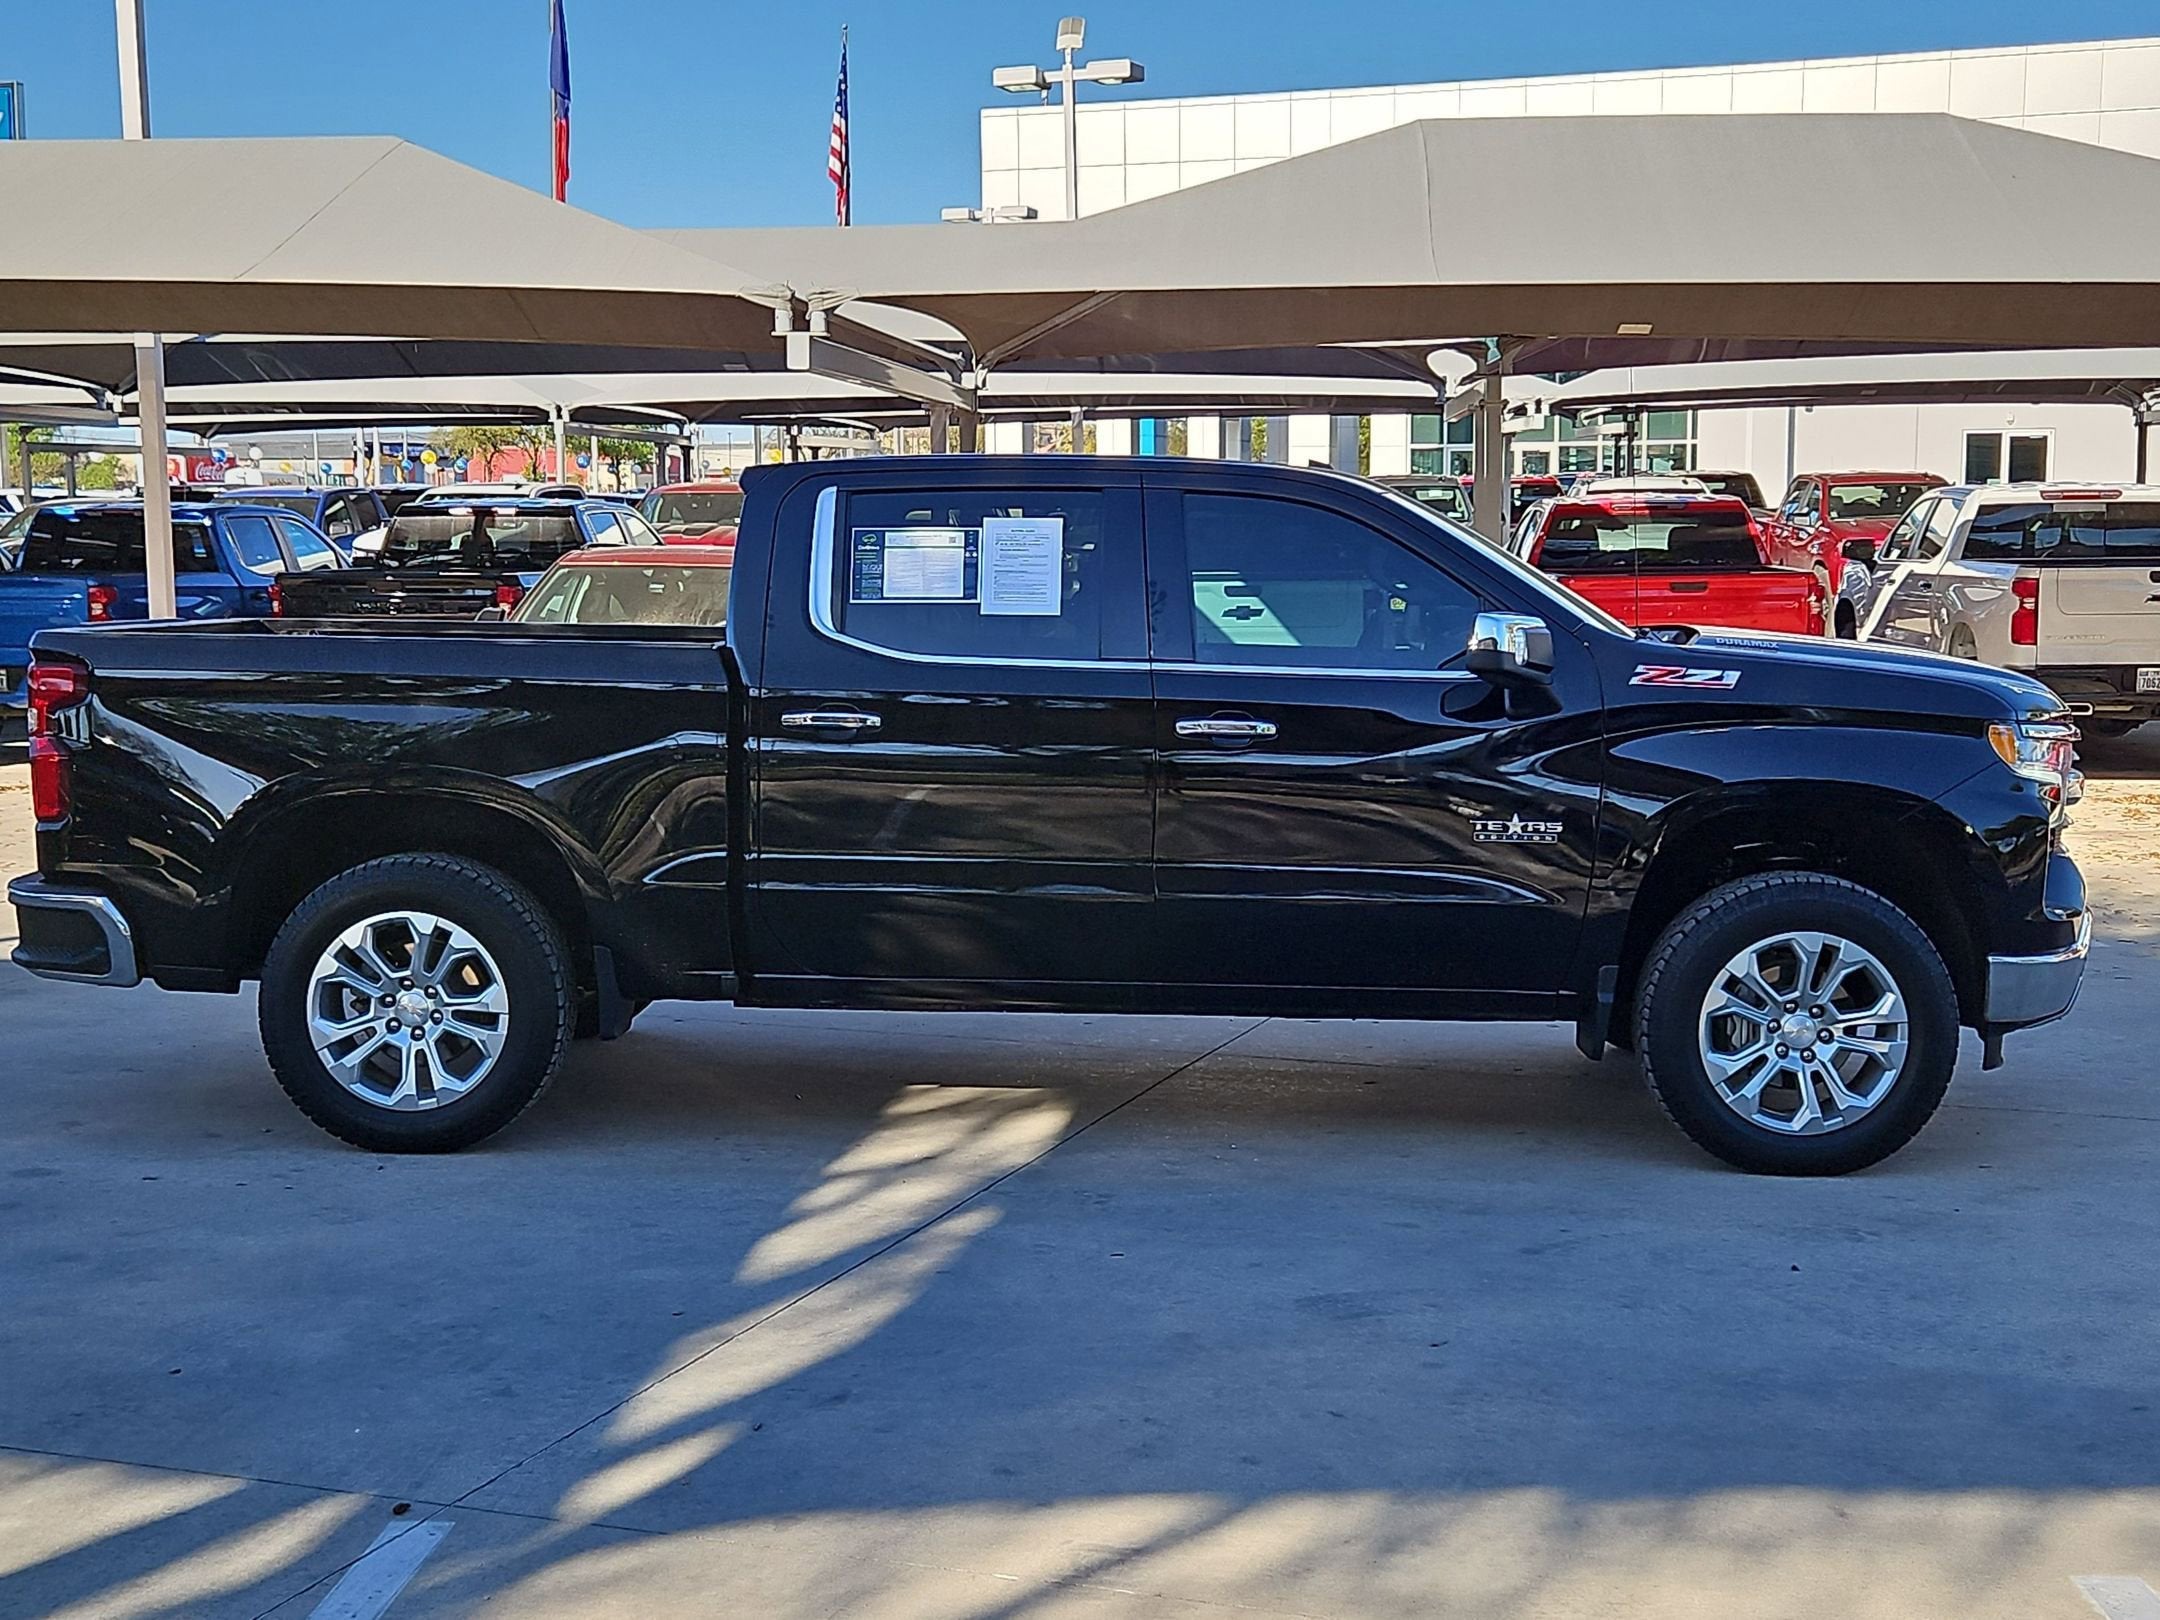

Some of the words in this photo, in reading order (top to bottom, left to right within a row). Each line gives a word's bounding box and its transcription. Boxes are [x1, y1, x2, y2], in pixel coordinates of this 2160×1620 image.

[195, 462, 229, 480] Coca-Col
[1715, 637, 1779, 649] DURAMAX
[1628, 664, 1741, 689] Z71
[1469, 813, 1563, 834] TEXAS
